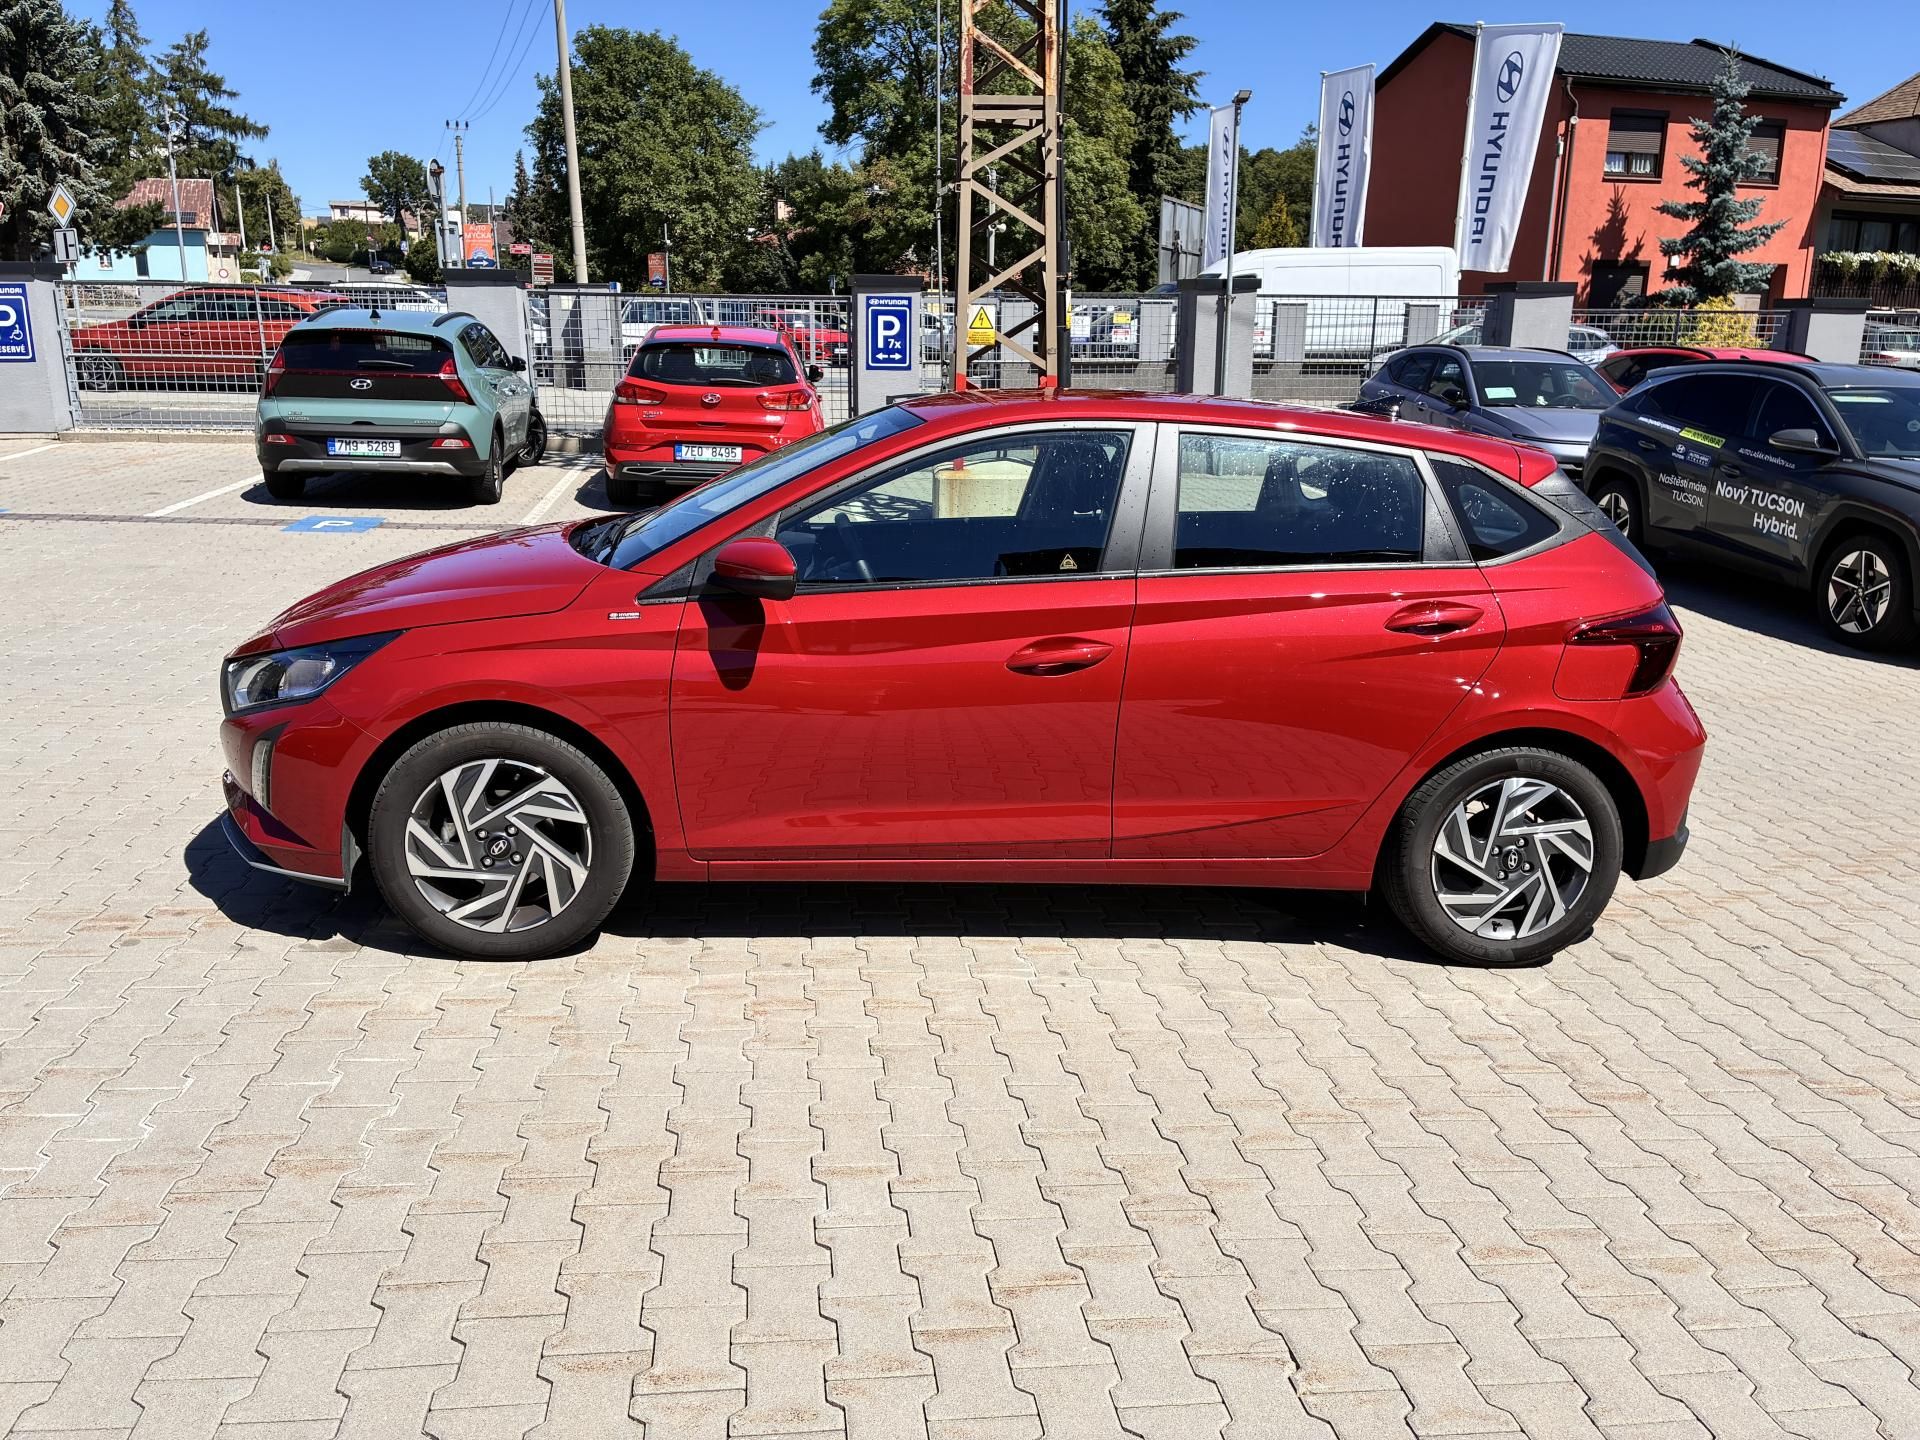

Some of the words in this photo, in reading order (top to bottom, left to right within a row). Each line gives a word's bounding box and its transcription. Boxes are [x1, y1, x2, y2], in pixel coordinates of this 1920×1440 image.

[1471, 112, 1510, 244] HYUNDAI
[1332, 143, 1351, 248] HYUNDA
[1220, 171, 1229, 259] HYUNDA
[877, 315, 901, 349] P
[887, 338, 902, 349] 7x
[337, 439, 359, 452] 7M9
[367, 440, 395, 453] 5289
[711, 446, 737, 458] 8495
[1658, 472, 1689, 489] Naštěstí
[1689, 480, 1707, 493] máte
[1672, 490, 1704, 507] TUCSON.
[1715, 481, 1749, 504] Nový
[1751, 489, 1805, 518] TUCSON
[312, 520, 354, 529] P
[1753, 512, 1798, 540] Hybrid.
